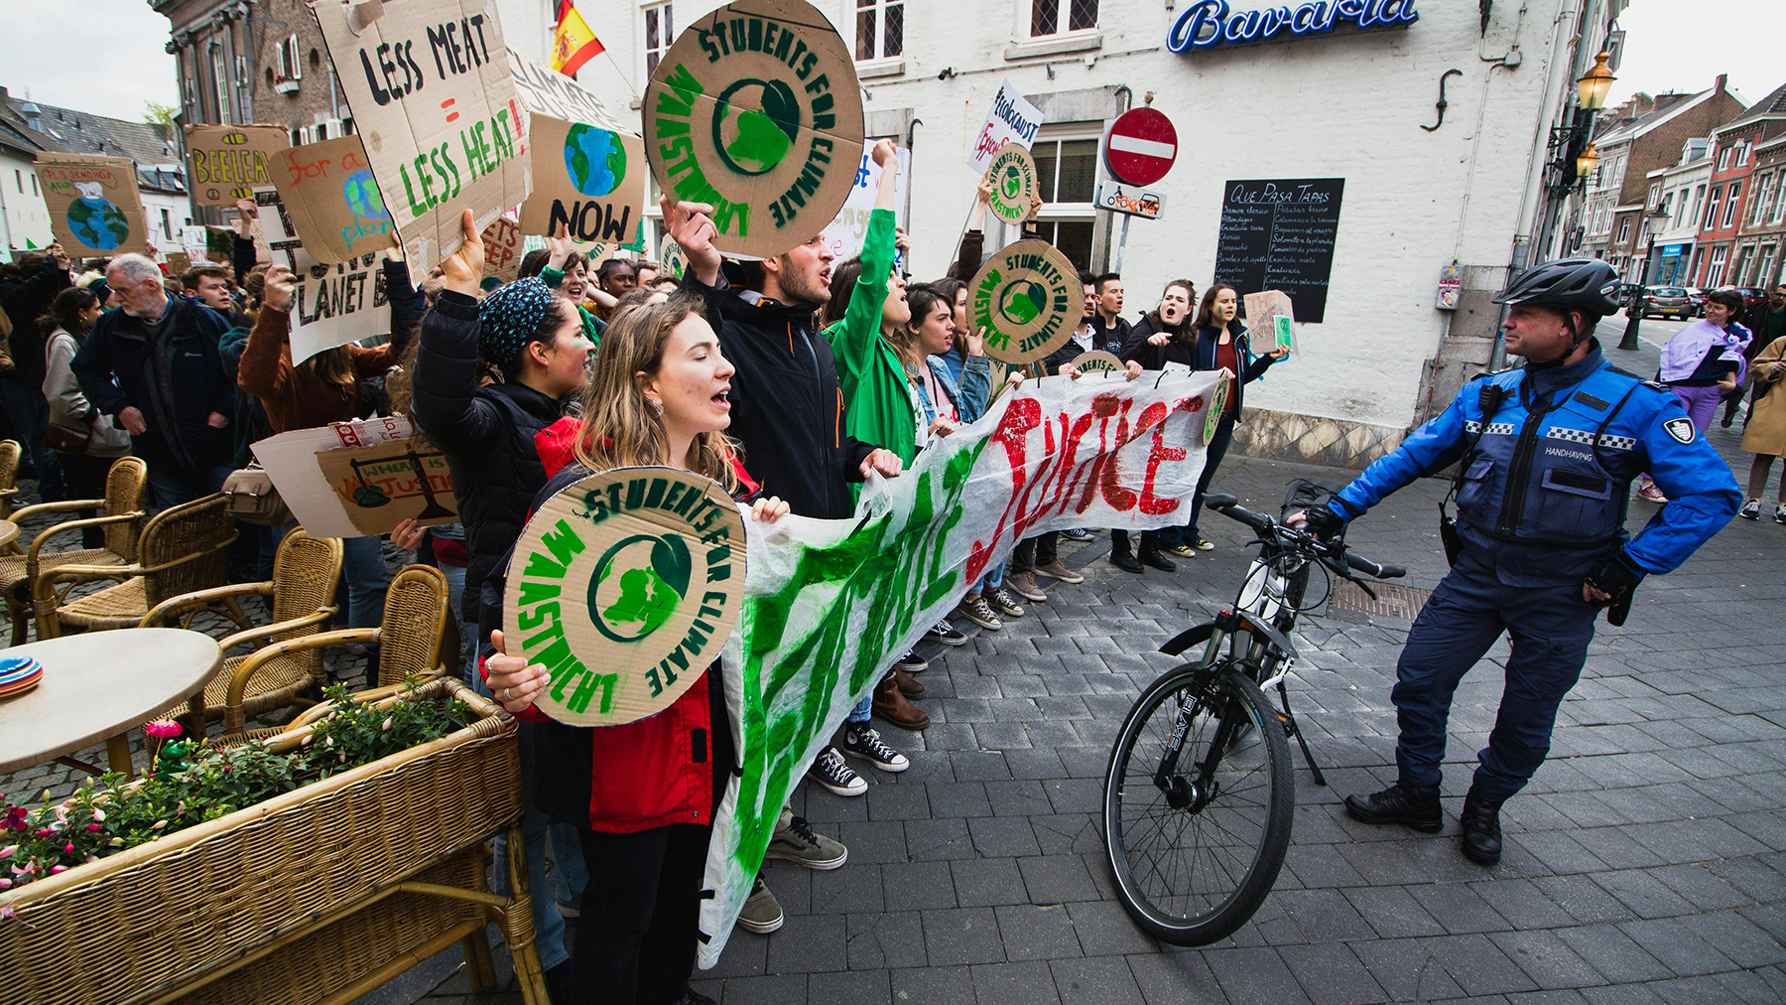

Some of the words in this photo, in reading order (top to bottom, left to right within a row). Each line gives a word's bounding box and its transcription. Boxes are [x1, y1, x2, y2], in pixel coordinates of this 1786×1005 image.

[359, 39, 424, 106] LESS
[426, 14, 491, 80] MEAT
[697, 17, 819, 81] STUDENTS
[804, 73, 836, 132] FOR
[400, 141, 462, 218] LESS
[768, 137, 833, 229] CLIMATE
[990, 151, 1013, 185] STUDENTS
[1022, 164, 1032, 198] CLIMATE
[549, 199, 630, 243] NOW
[1006, 254, 1063, 286] STUDENTS
[1052, 286, 1068, 313] FOR
[1019, 314, 1064, 353] CLIMATE
[1545, 447, 1593, 463] HANDHAVING
[584, 478, 724, 532] STUDENTS
[701, 526, 732, 585] FOR
[518, 518, 619, 715] MAASTRICHT
[644, 591, 728, 698] CLIMATE
